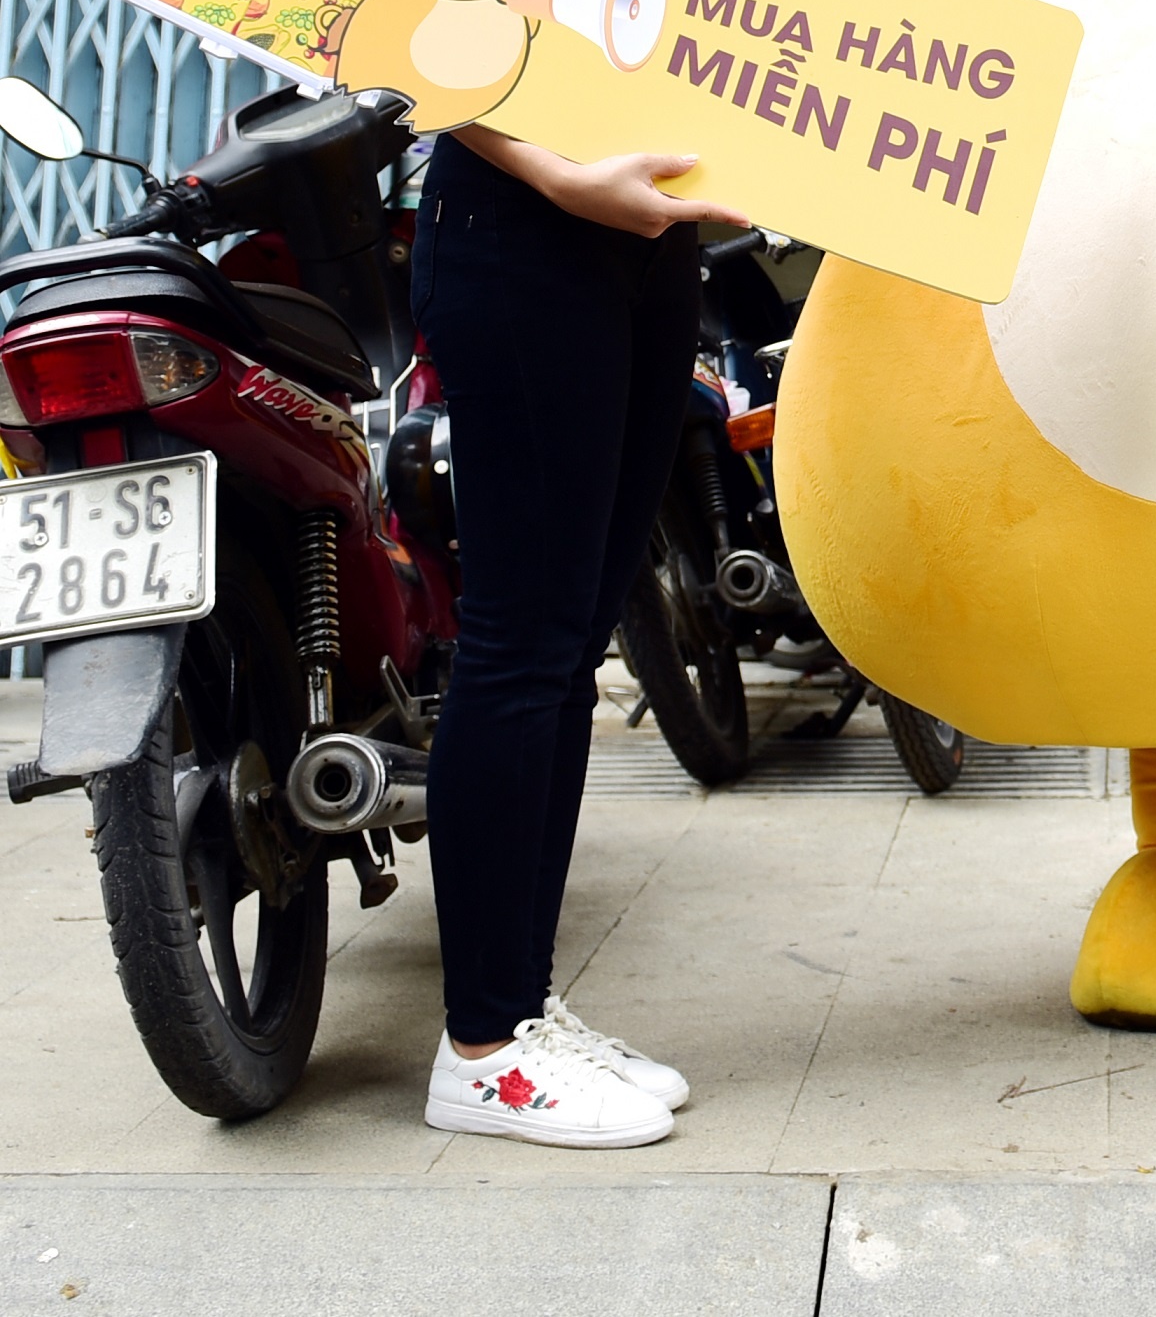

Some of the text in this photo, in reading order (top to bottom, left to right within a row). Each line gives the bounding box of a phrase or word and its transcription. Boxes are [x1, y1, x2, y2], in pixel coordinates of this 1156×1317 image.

[835, 18, 1016, 100] HÀNG
[666, 34, 1008, 216] MIỄN PHÍ
[15, 542, 169, 624] 2864
